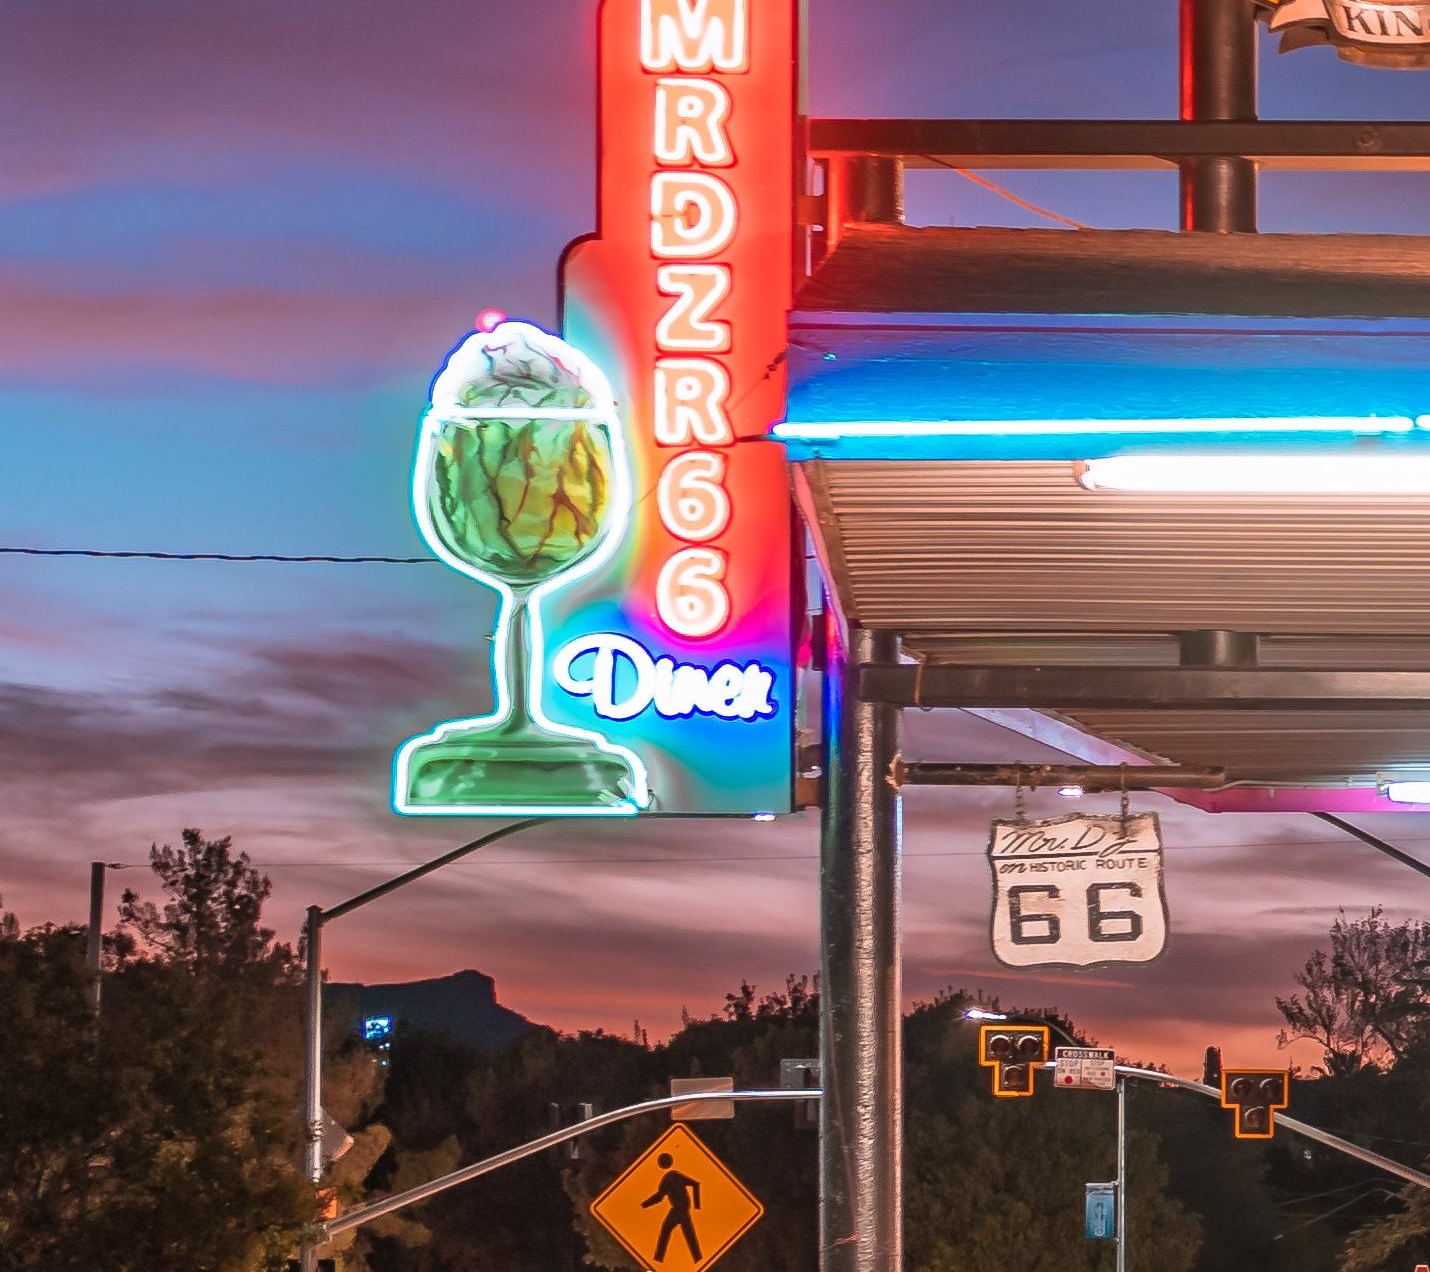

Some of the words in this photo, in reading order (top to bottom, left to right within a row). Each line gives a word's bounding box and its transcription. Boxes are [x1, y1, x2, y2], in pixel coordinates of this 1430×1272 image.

[552, 632, 779, 723] Diner
[1000, 863, 1028, 874] on
[1030, 860, 1087, 872] HISTORIC
[1096, 858, 1148, 869] ROUTE
[1008, 882, 1143, 945] 66
